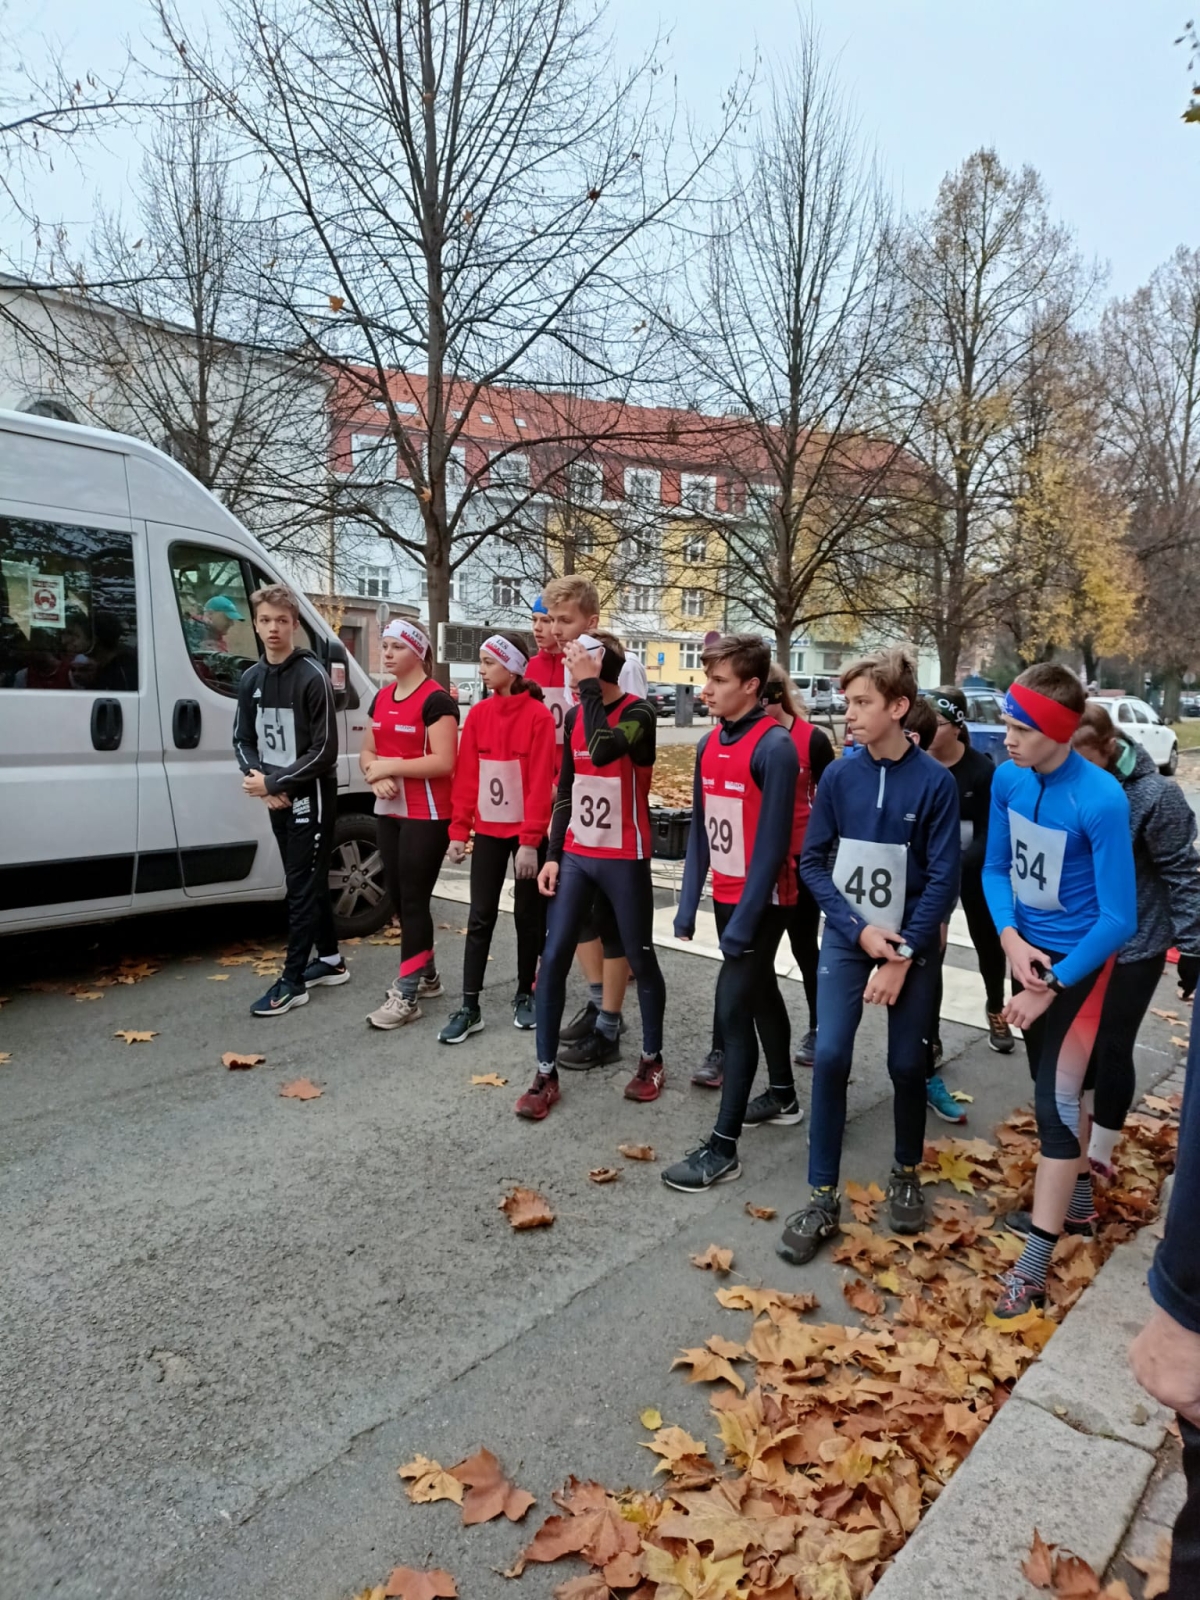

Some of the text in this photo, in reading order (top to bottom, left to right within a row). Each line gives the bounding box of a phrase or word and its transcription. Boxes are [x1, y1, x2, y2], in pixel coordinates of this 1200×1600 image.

[263, 724, 286, 752] 51
[490, 777, 509, 806] 9.
[580, 794, 612, 829] 32
[709, 816, 733, 855] 29
[1015, 838, 1047, 891] 54
[844, 865, 892, 908] 48
